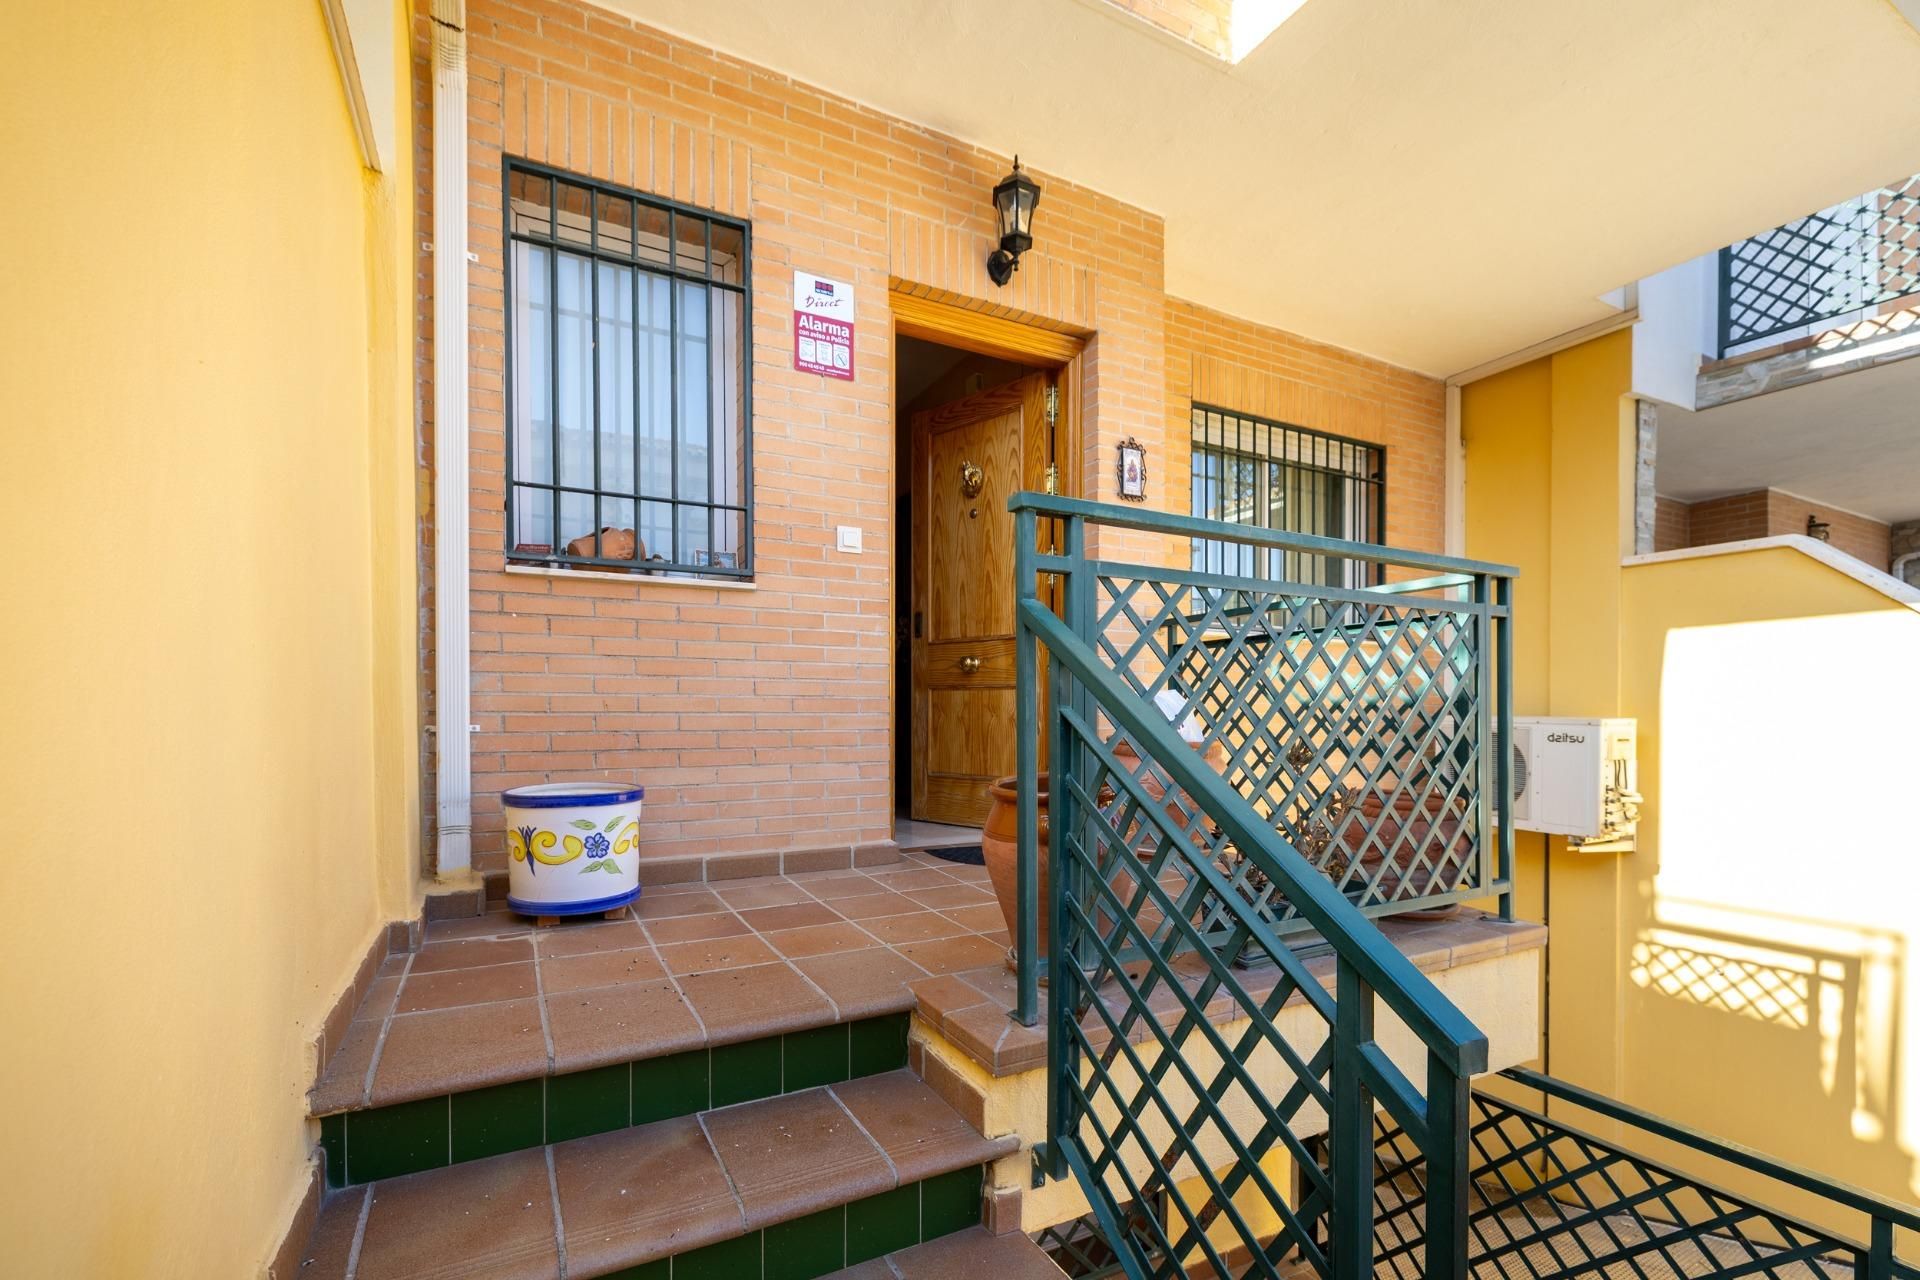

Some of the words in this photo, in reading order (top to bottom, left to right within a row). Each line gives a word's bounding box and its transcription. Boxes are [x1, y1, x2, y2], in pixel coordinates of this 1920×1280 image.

[805, 295, 845, 308] Direct
[799, 314, 850, 338] Alarma
[810, 331, 826, 340] aviso
[1547, 733, 1585, 744] daitsu
